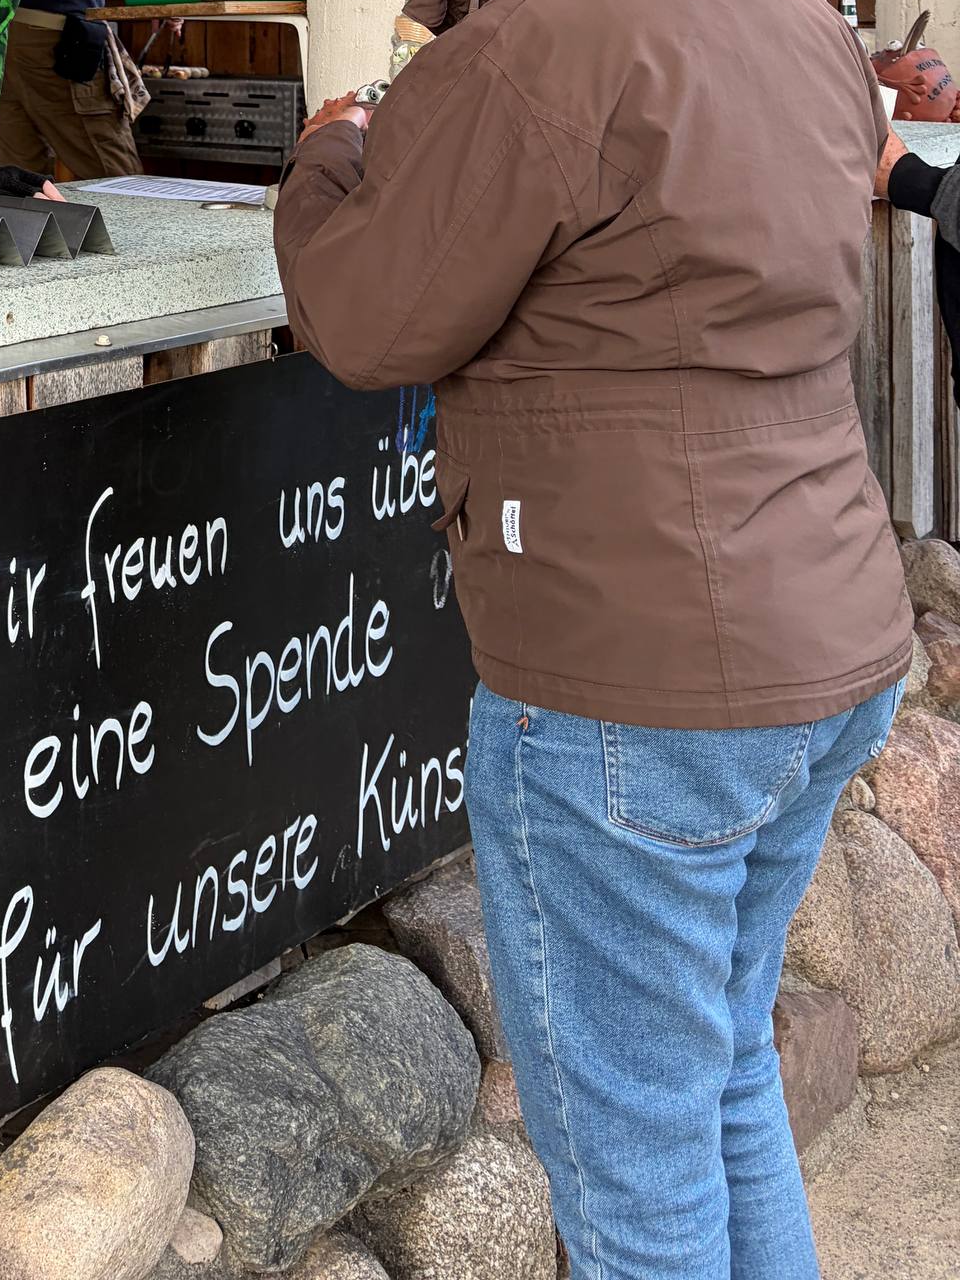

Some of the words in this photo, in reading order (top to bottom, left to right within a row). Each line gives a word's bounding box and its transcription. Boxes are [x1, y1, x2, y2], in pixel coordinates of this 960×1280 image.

[81, 486, 228, 670] freuen
[278, 474, 346, 549] uns
[372, 424, 438, 522] übe
[23, 700, 155, 819] eine
[197, 572, 394, 768] Spende
[147, 813, 318, 967] unsere
[358, 733, 471, 858] Küns
